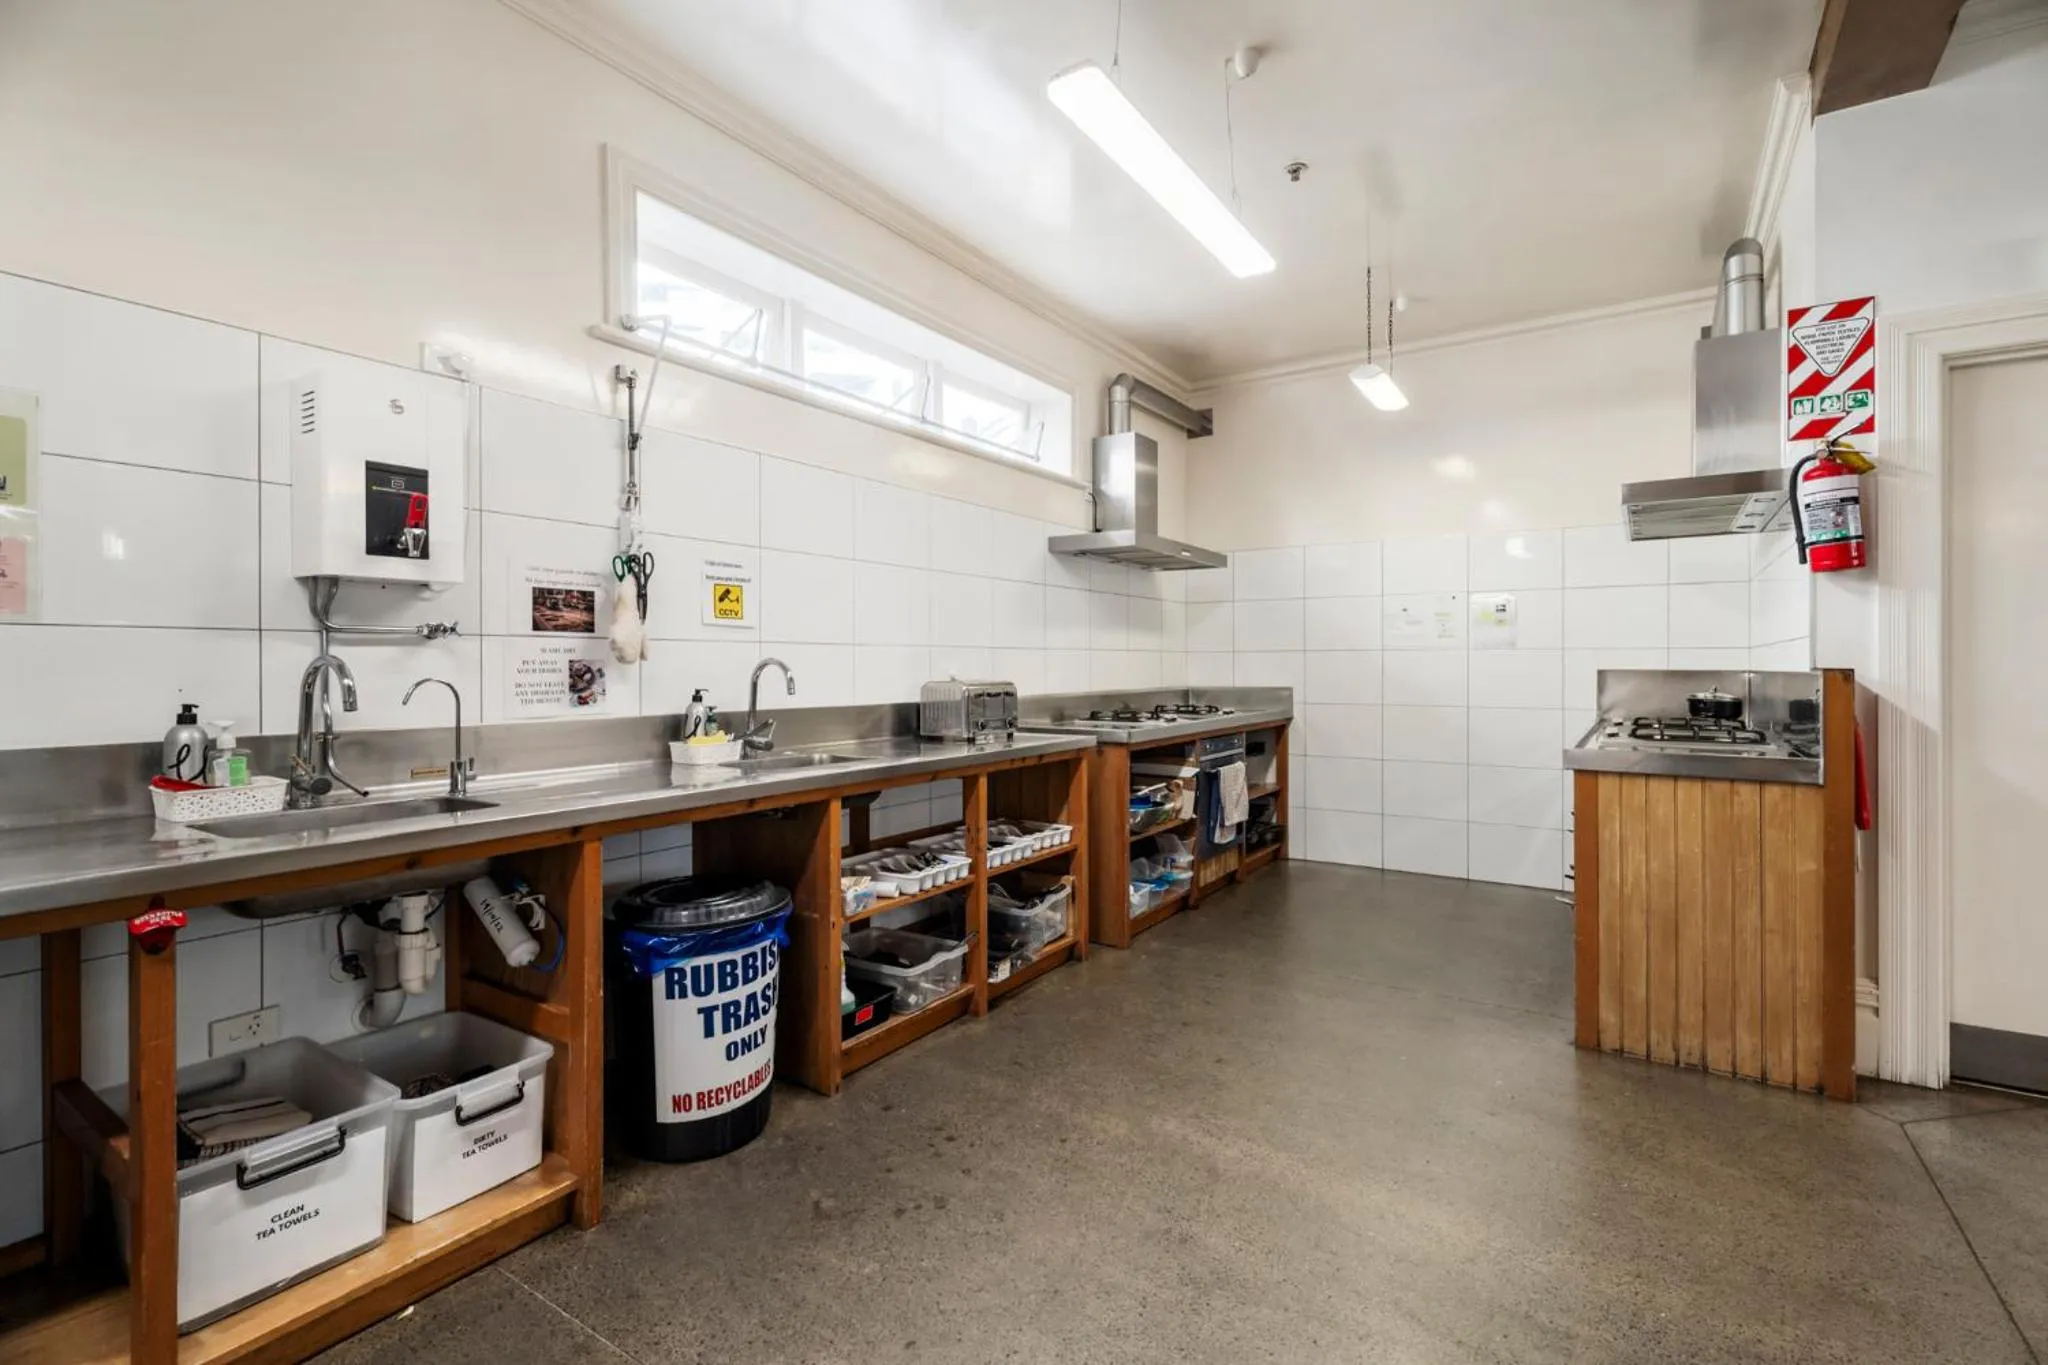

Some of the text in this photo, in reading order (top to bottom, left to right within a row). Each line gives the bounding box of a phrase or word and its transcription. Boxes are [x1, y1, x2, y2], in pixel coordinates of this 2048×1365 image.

[718, 608, 739, 617] CCTV
[664, 938, 779, 1000] RUBBIS
[725, 1024, 768, 1061] ONLY
[672, 1058, 771, 1114] NO RECYCLABLES
[462, 1133, 508, 1159] TEA TOWELS
[256, 1207, 320, 1240] TEA TOWELS
[270, 1203, 305, 1224] CLEAN
